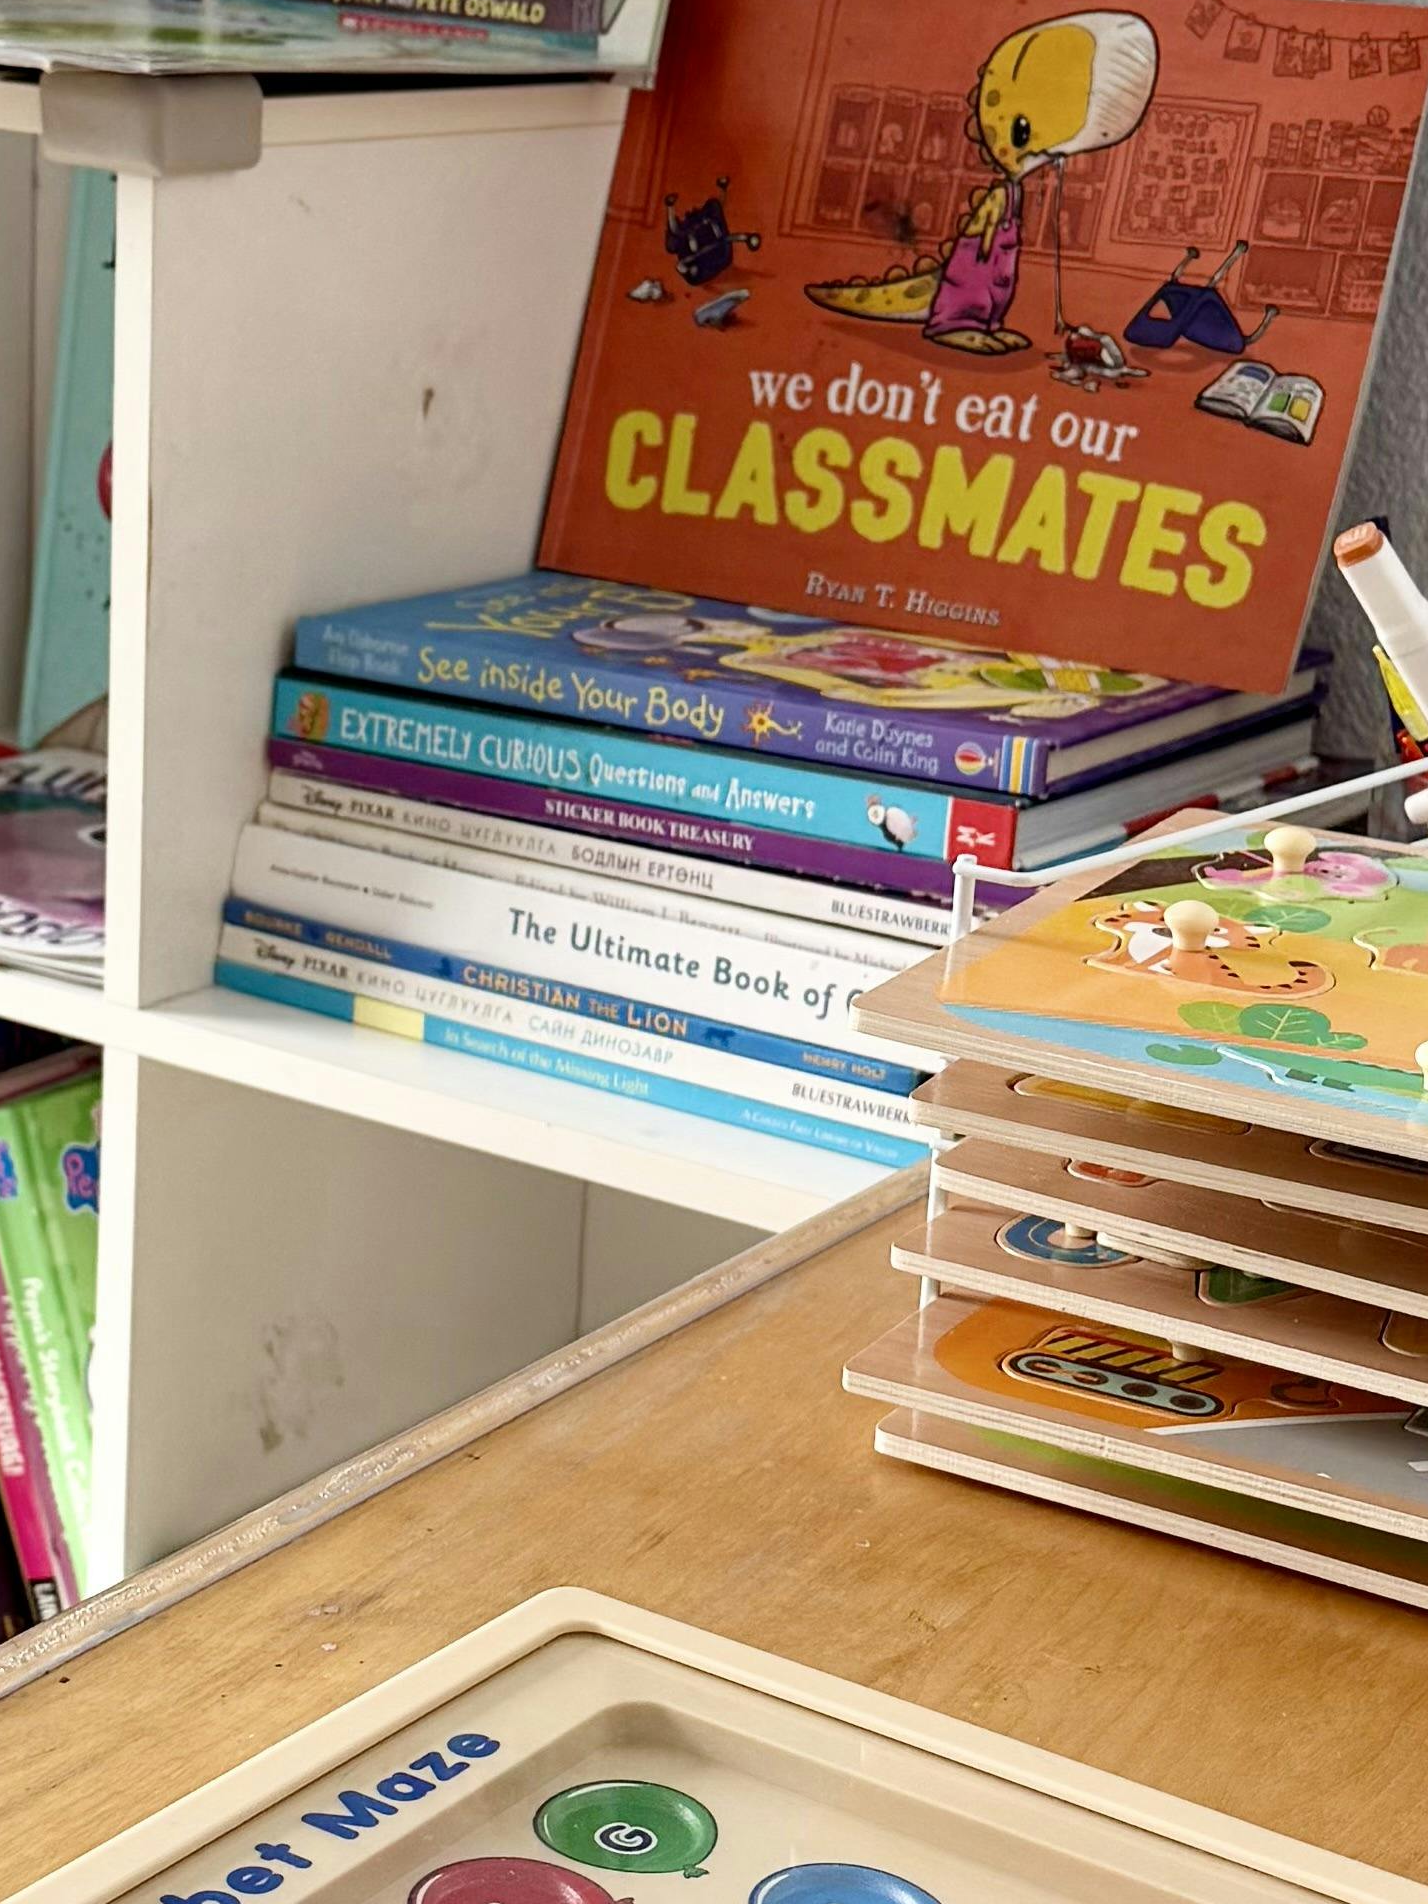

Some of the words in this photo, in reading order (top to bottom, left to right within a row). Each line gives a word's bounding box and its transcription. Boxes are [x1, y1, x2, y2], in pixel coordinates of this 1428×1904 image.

[748, 368, 814, 410] we
[827, 361, 943, 429] don't
[955, 385, 1040, 444] eat
[1049, 408, 1140, 464] our
[605, 408, 1269, 610] CLASSMATES
[418, 646, 471, 685] See
[480, 658, 565, 704] inside
[572, 672, 638, 722] Your
[645, 685, 725, 739] Body
[824, 711, 865, 737] Katie
[340, 707, 472, 762] EXTREMELY
[587, 752, 688, 798] Questions
[724, 777, 817, 820] Answers
[815, 738, 850, 758] and
[853, 740, 898, 765] Colin
[901, 747, 941, 777] King
[349, 800, 396, 822] PIXAR
[543, 798, 617, 829] STICKER
[617, 809, 667, 838] BOOK
[669, 815, 755, 853] TREASURY
[302, 952, 349, 982] PIXAR
[462, 963, 582, 1011] CHRISTIAN
[626, 998, 689, 1039] LION
[508, 906, 557, 946] The
[570, 921, 701, 979] Ultimate
[712, 955, 791, 1002] Book
[803, 982, 837, 1021] of
[300, 1731, 503, 1842] Maze
[594, 1822, 659, 1857] G
